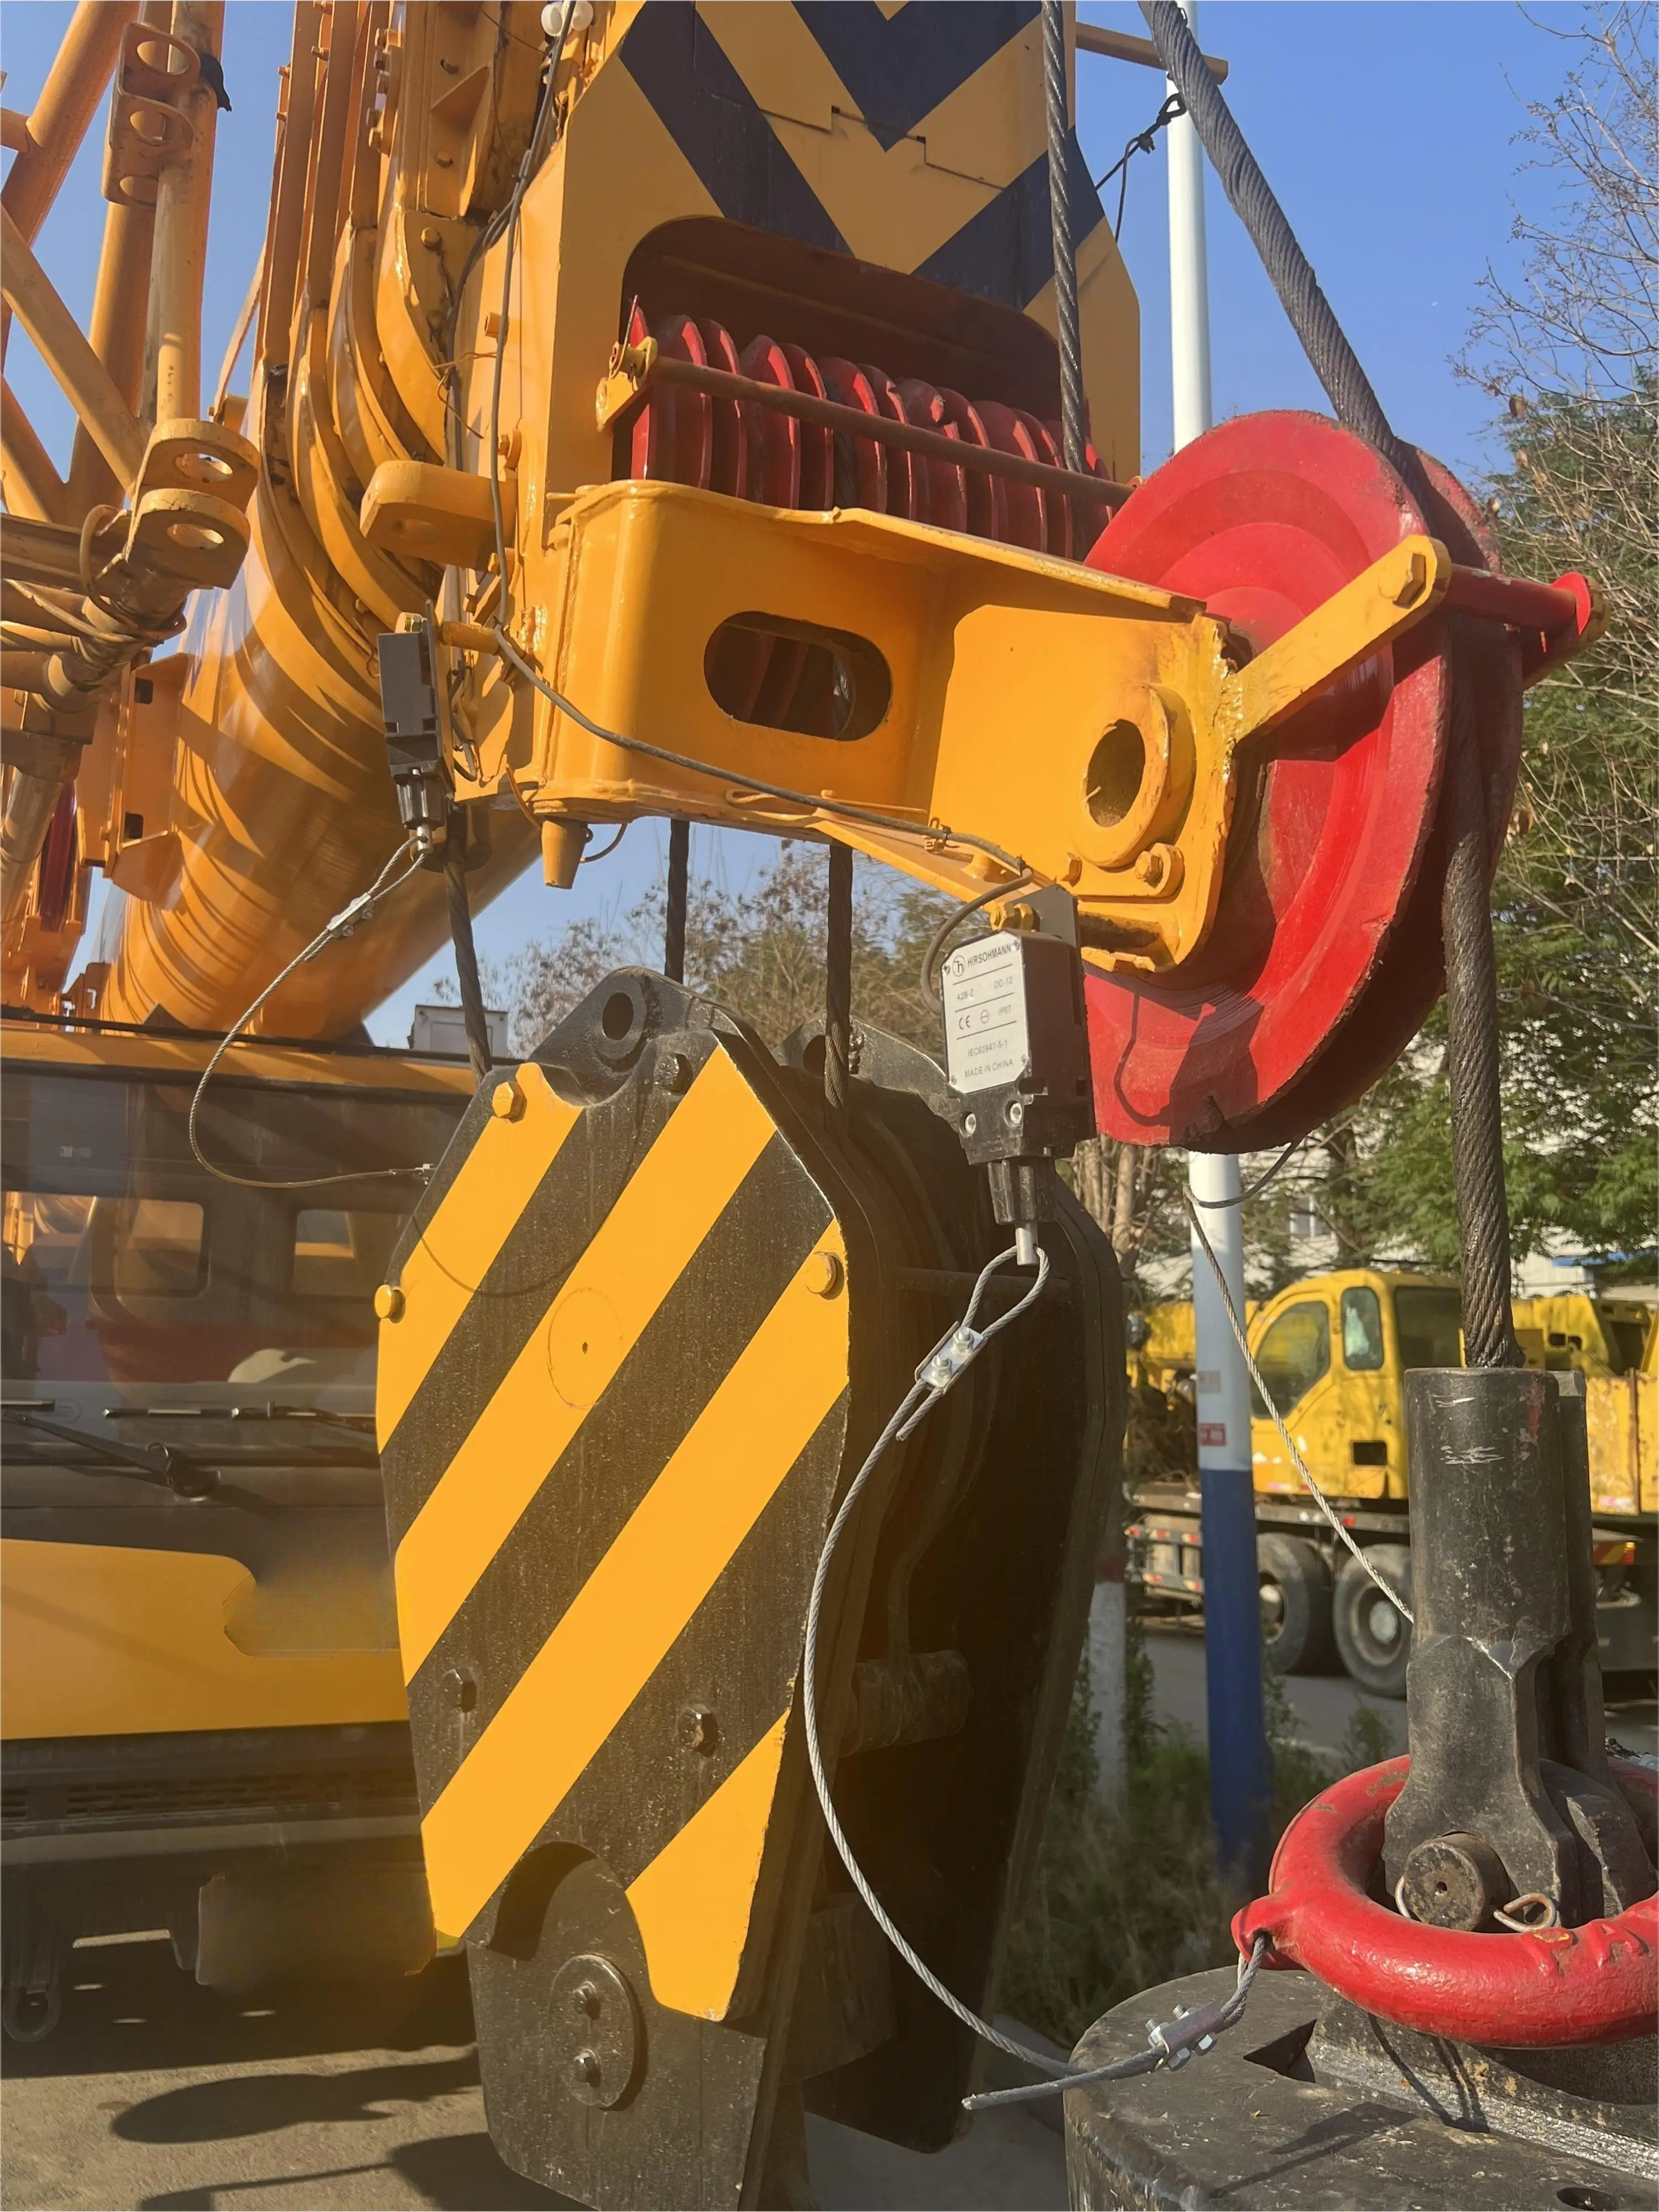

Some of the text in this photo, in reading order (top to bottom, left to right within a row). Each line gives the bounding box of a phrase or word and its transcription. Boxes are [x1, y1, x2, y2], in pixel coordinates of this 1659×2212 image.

[994, 976, 1013, 989] DC-12
[967, 1039, 1008, 1057] IEC60947-5-1
[964, 1058, 1014, 1078] MADE IN CHINA
